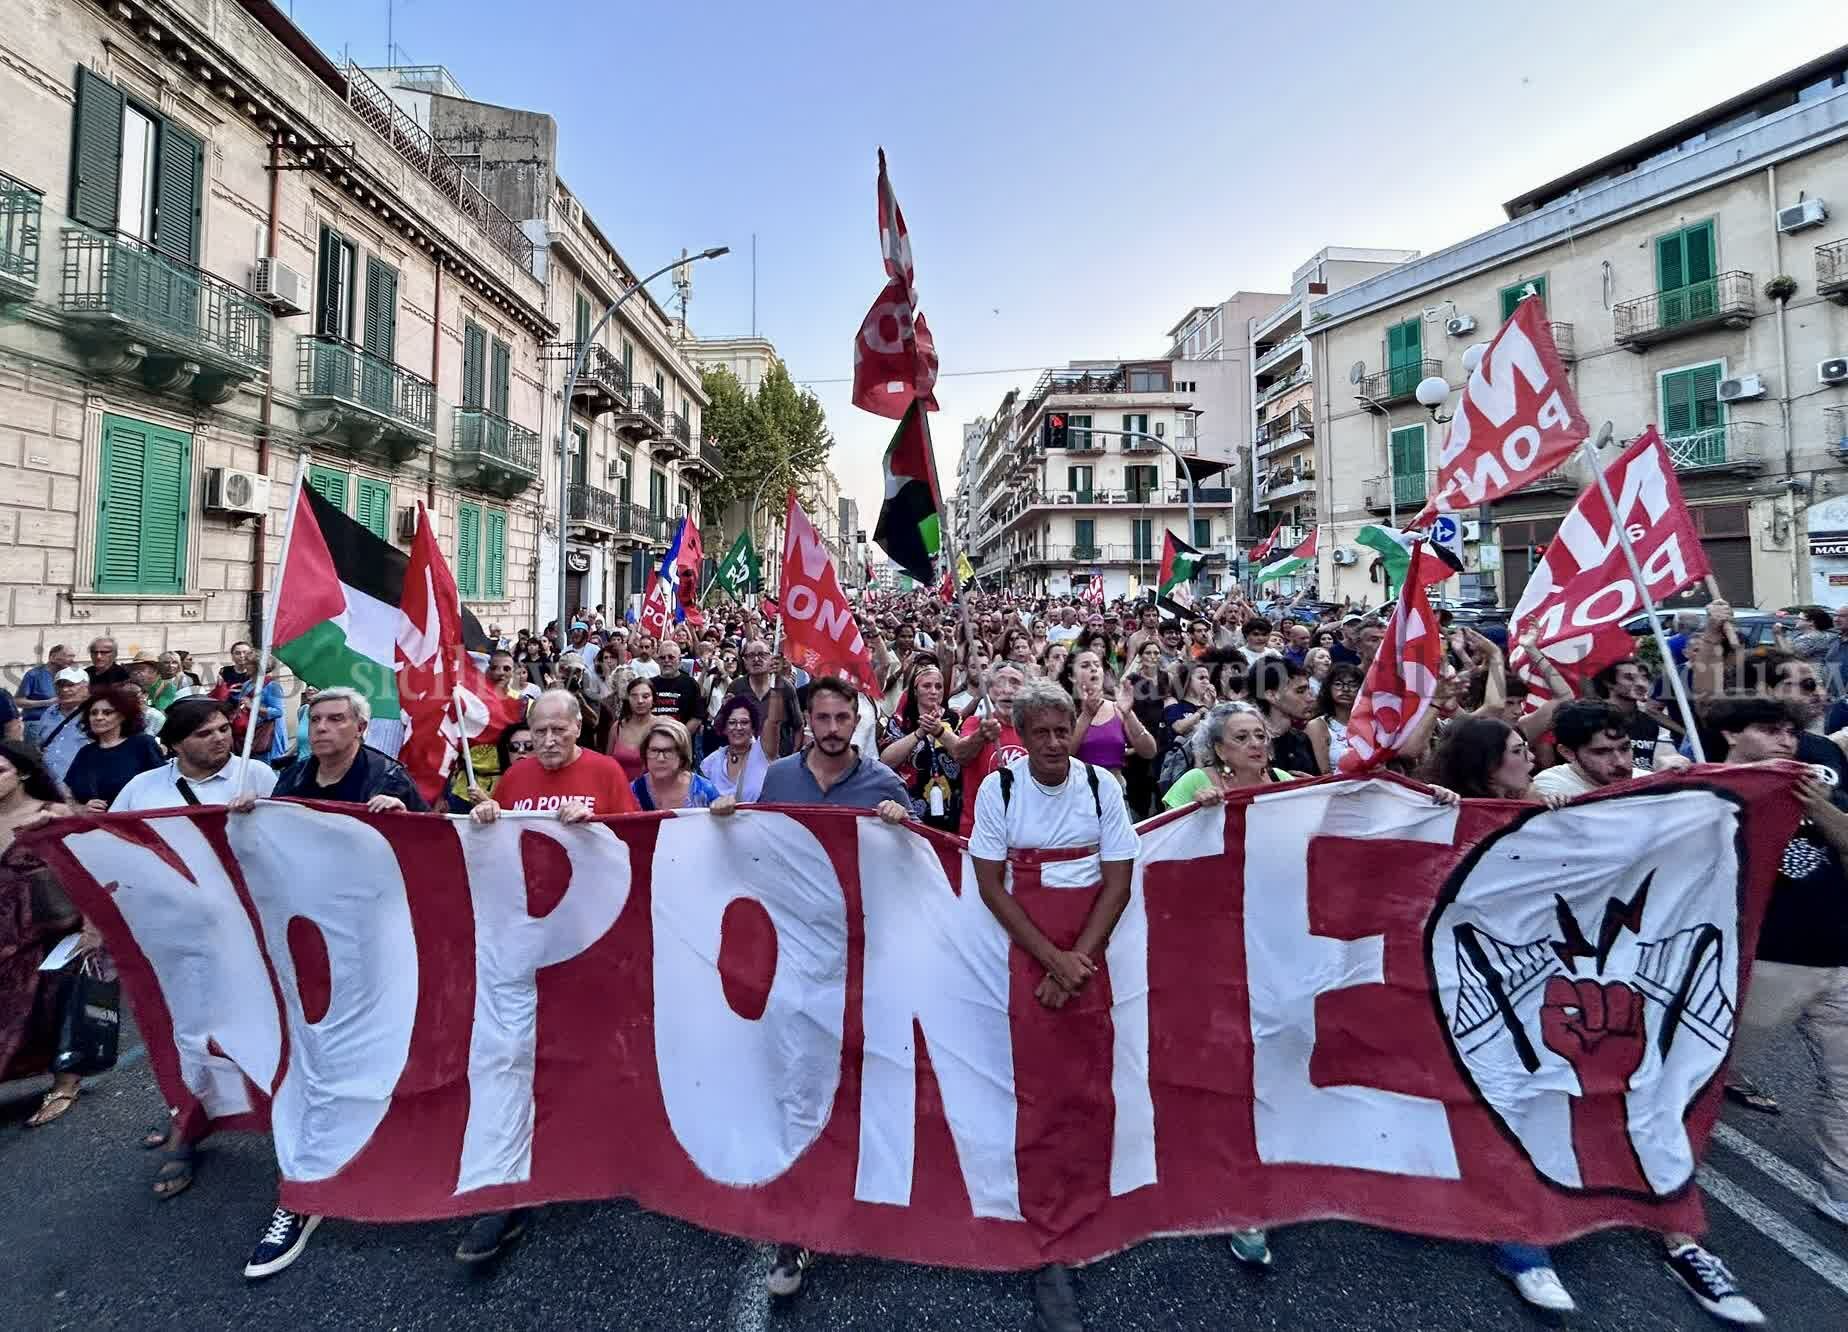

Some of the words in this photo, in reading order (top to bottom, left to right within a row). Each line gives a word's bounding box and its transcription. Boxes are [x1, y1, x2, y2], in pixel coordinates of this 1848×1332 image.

[513, 798, 533, 811] NO
[64, 798, 420, 1183] NO
[453, 778, 1463, 1221] PONTE
